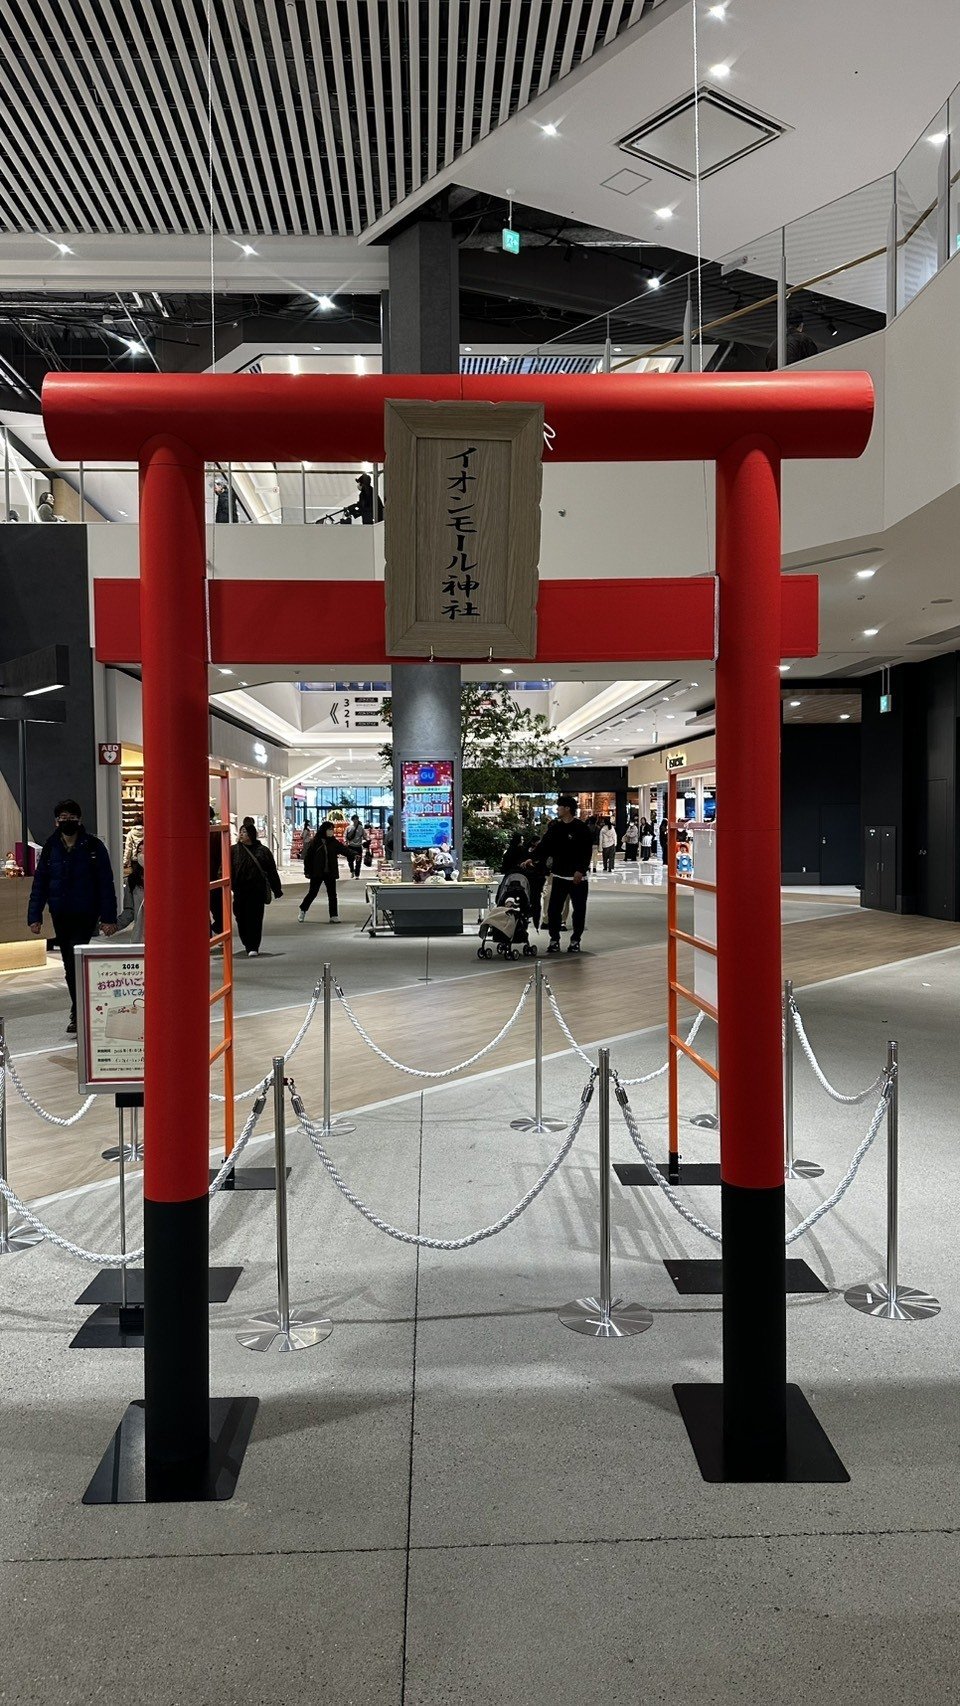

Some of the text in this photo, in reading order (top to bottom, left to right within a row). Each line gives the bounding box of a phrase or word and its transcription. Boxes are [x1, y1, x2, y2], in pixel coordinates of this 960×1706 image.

[440, 447, 481, 620] イオンモール神社
[344, 698, 350, 707] 3
[344, 709, 350, 718] 2
[345, 720, 349, 728] 1
[421, 772, 434, 780] GU
[97, 978, 145, 990] おねがいご
